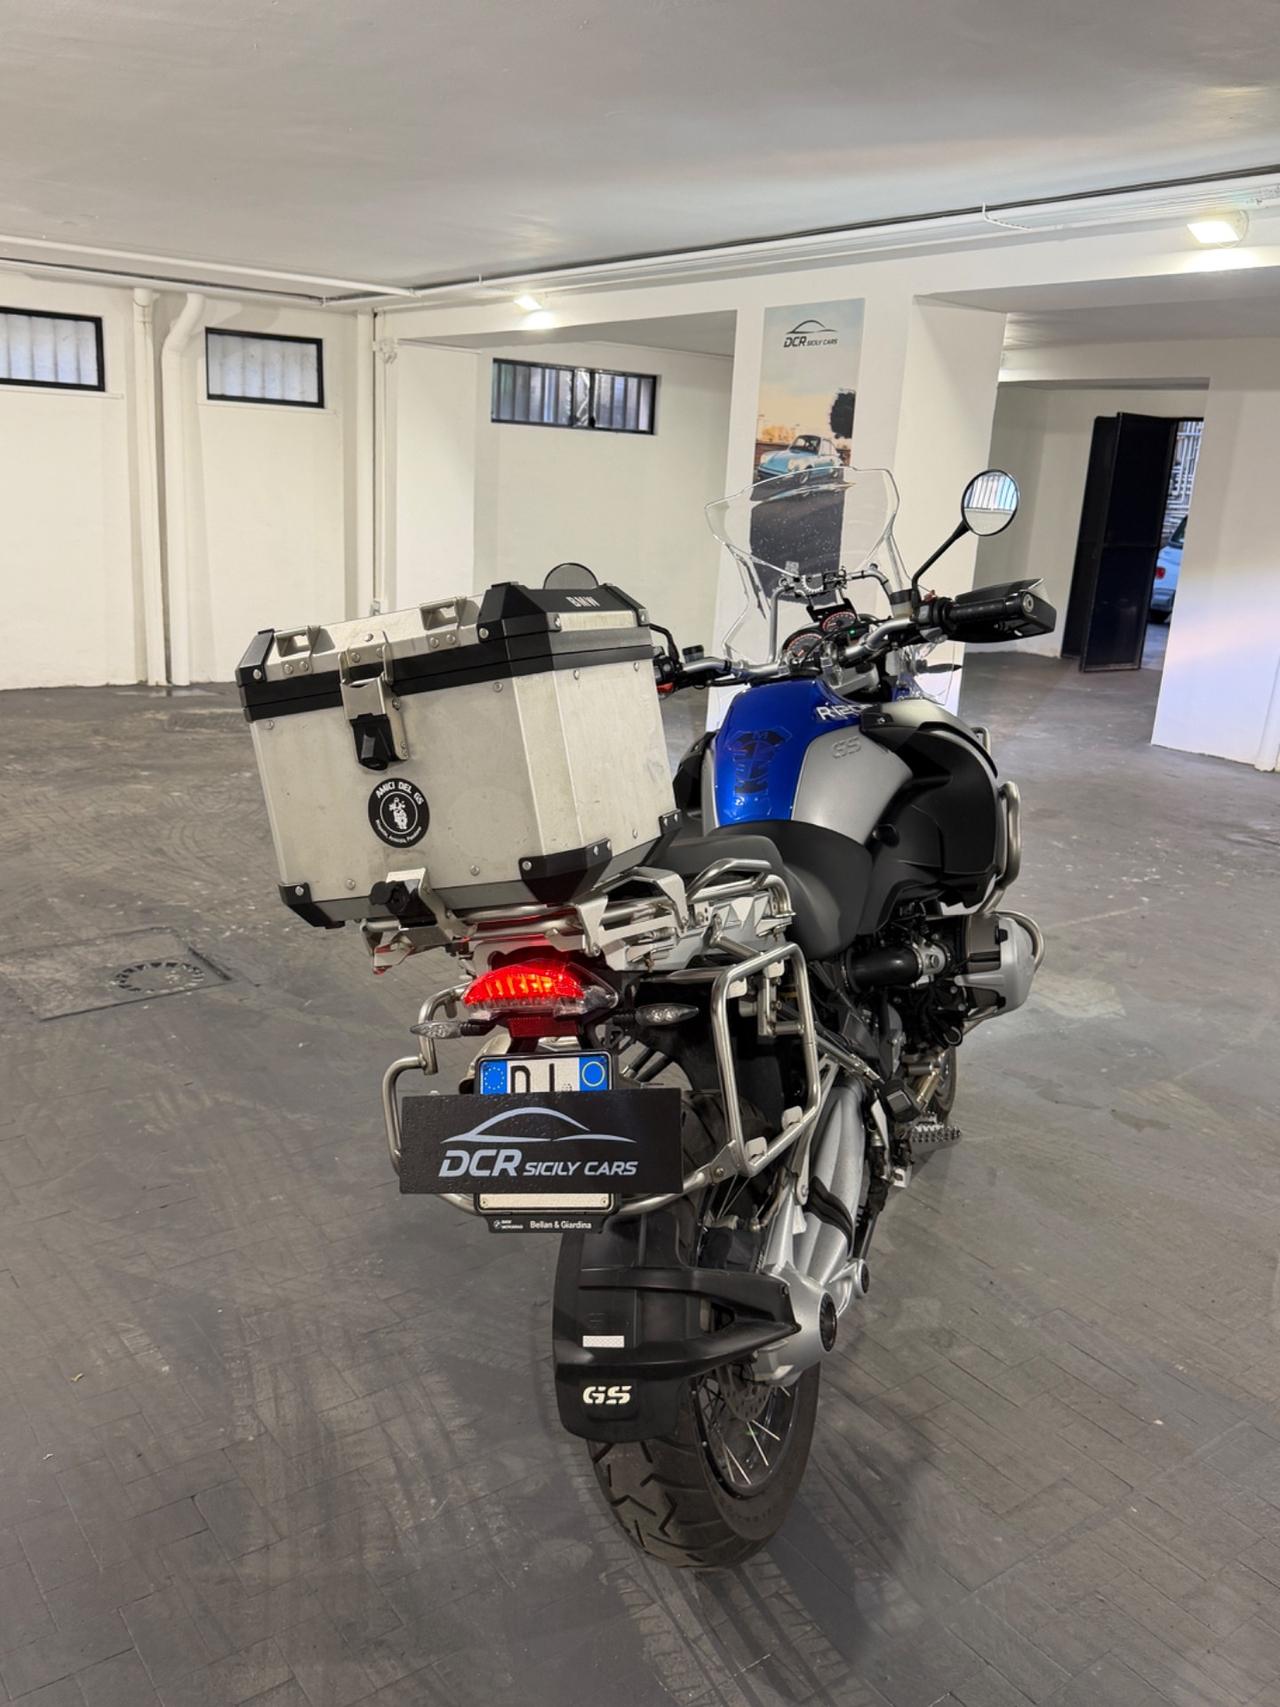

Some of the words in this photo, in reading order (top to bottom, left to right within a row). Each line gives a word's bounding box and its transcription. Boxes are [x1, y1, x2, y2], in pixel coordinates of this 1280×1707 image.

[784, 336, 807, 348] DCR
[376, 781, 395, 798] AMICI
[398, 781, 412, 793] DEL
[413, 792, 424, 805] GS
[438, 1149, 523, 1177] DCR
[523, 1161, 582, 1176] SICILY
[584, 1161, 639, 1176] CARS
[530, 1220, 553, 1229] Bellan
[554, 1221, 560, 1229] &
[561, 1220, 592, 1229] Giardina
[582, 1385, 632, 1405] GS
